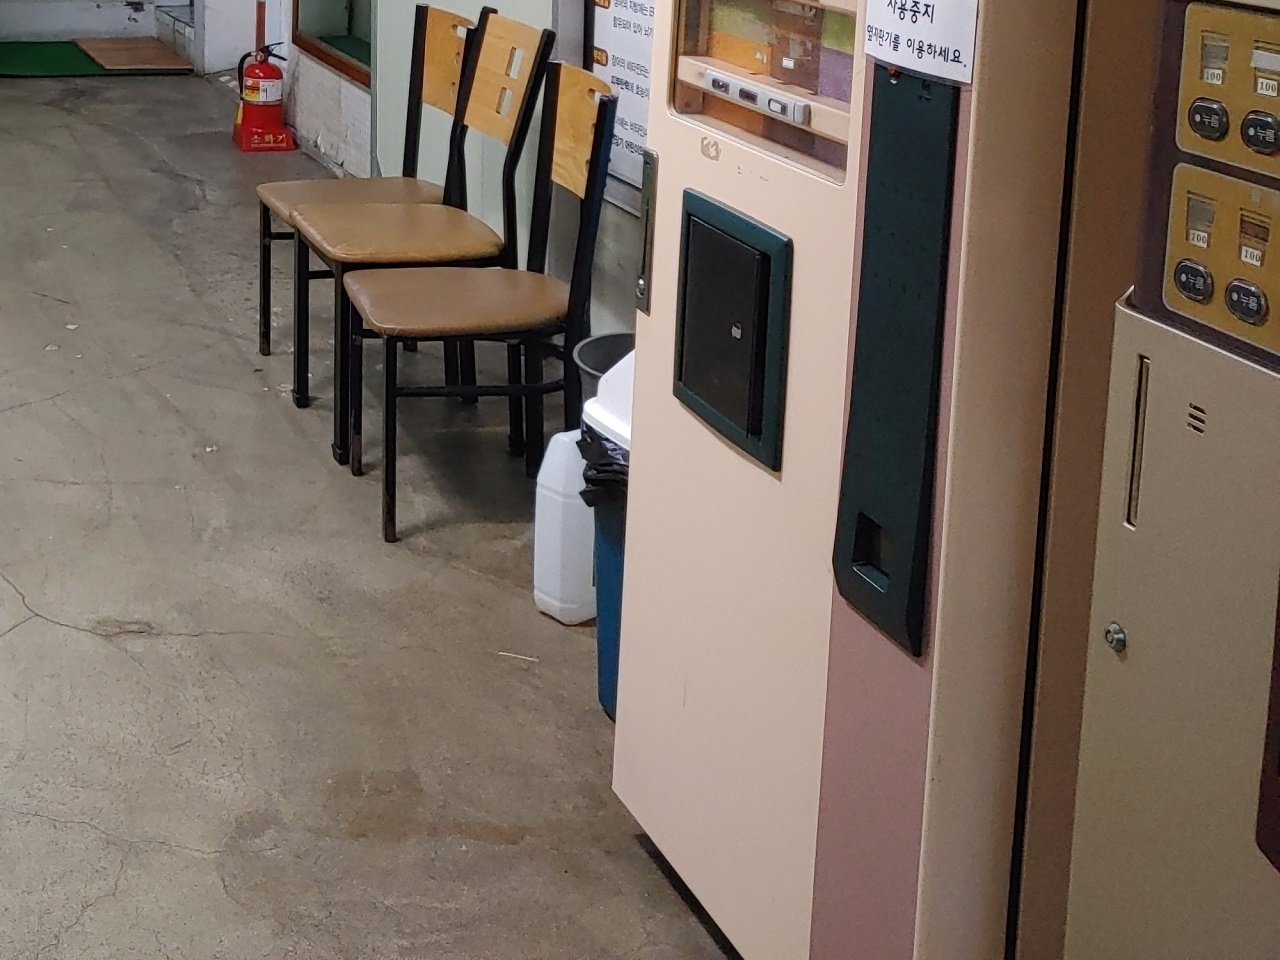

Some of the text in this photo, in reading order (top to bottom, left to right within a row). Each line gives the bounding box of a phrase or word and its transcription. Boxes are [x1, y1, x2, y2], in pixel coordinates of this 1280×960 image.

[866, 24, 968, 68] 옆자판기를 이용하세요.
[1205, 71, 1221, 82] 100
[1259, 81, 1277, 93] 100
[1190, 232, 1207, 245] 100
[1244, 249, 1261, 263] 100
